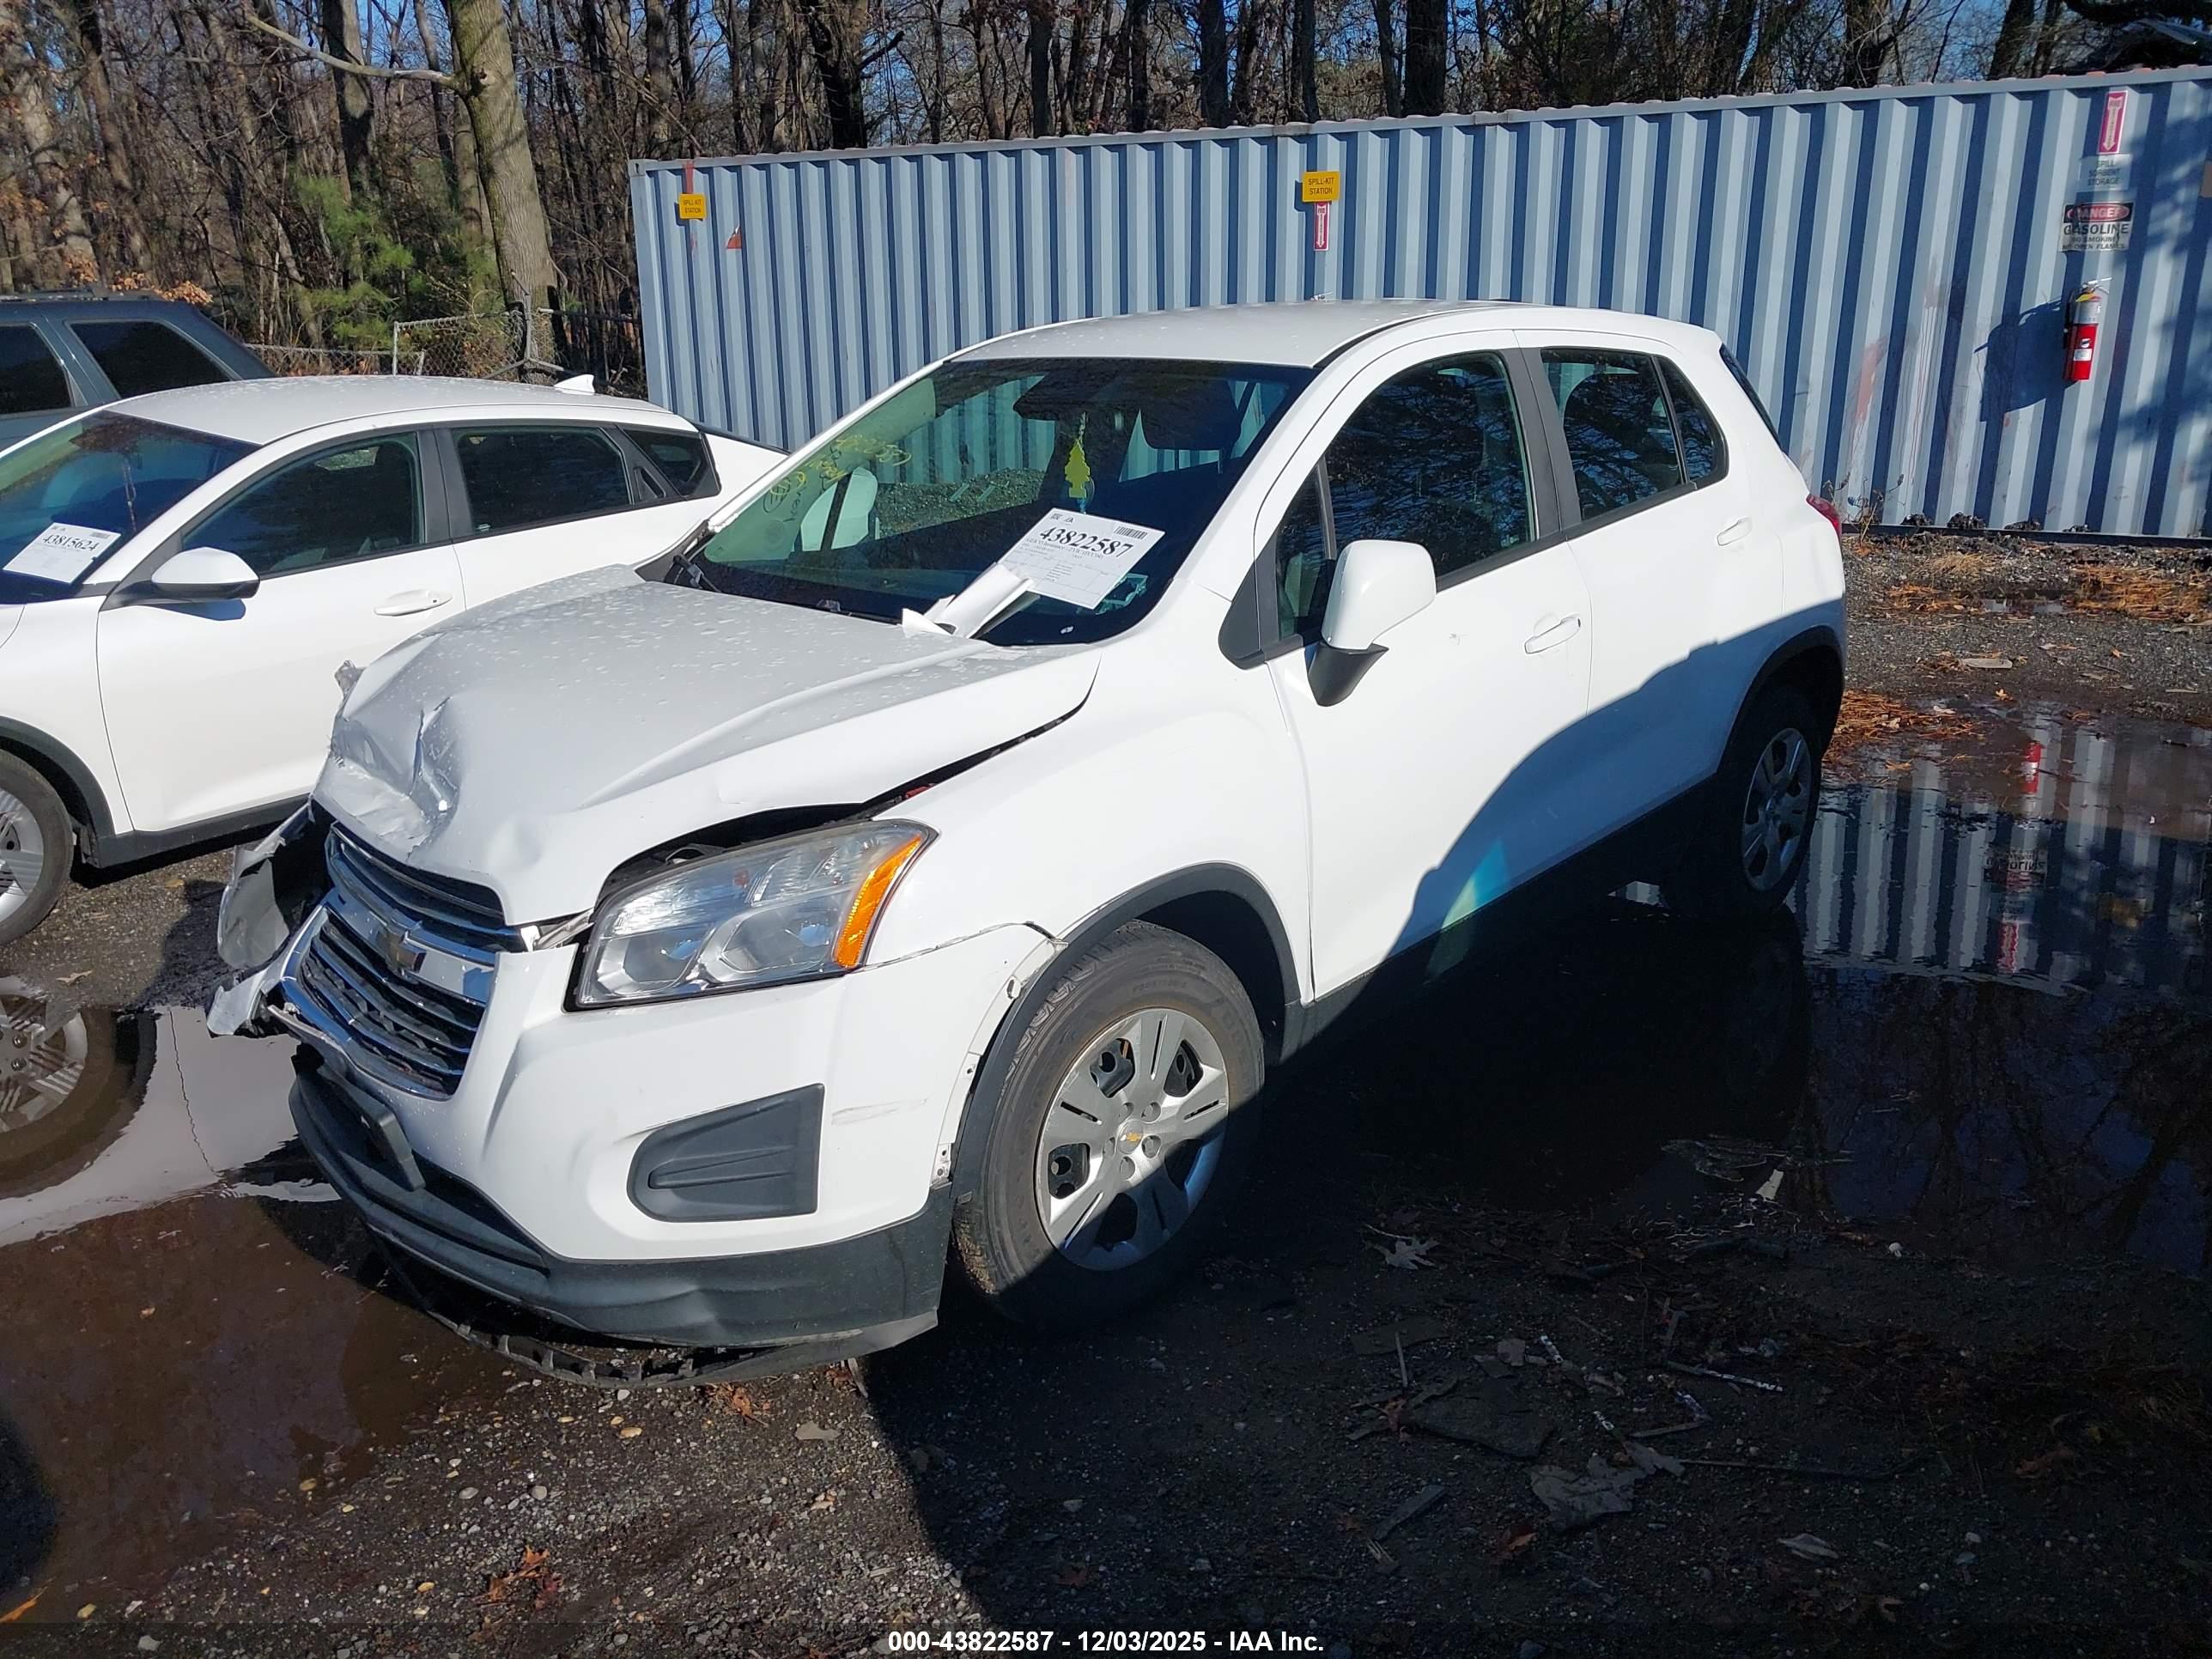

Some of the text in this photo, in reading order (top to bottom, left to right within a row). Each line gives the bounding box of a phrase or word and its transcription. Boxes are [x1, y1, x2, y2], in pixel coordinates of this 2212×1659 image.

[1308, 177, 1334, 185] SPILL-KIT
[2063, 223, 2130, 234] GASOLINE
[42, 534, 100, 551] 43815624
[1039, 526, 1134, 558] 43822587
